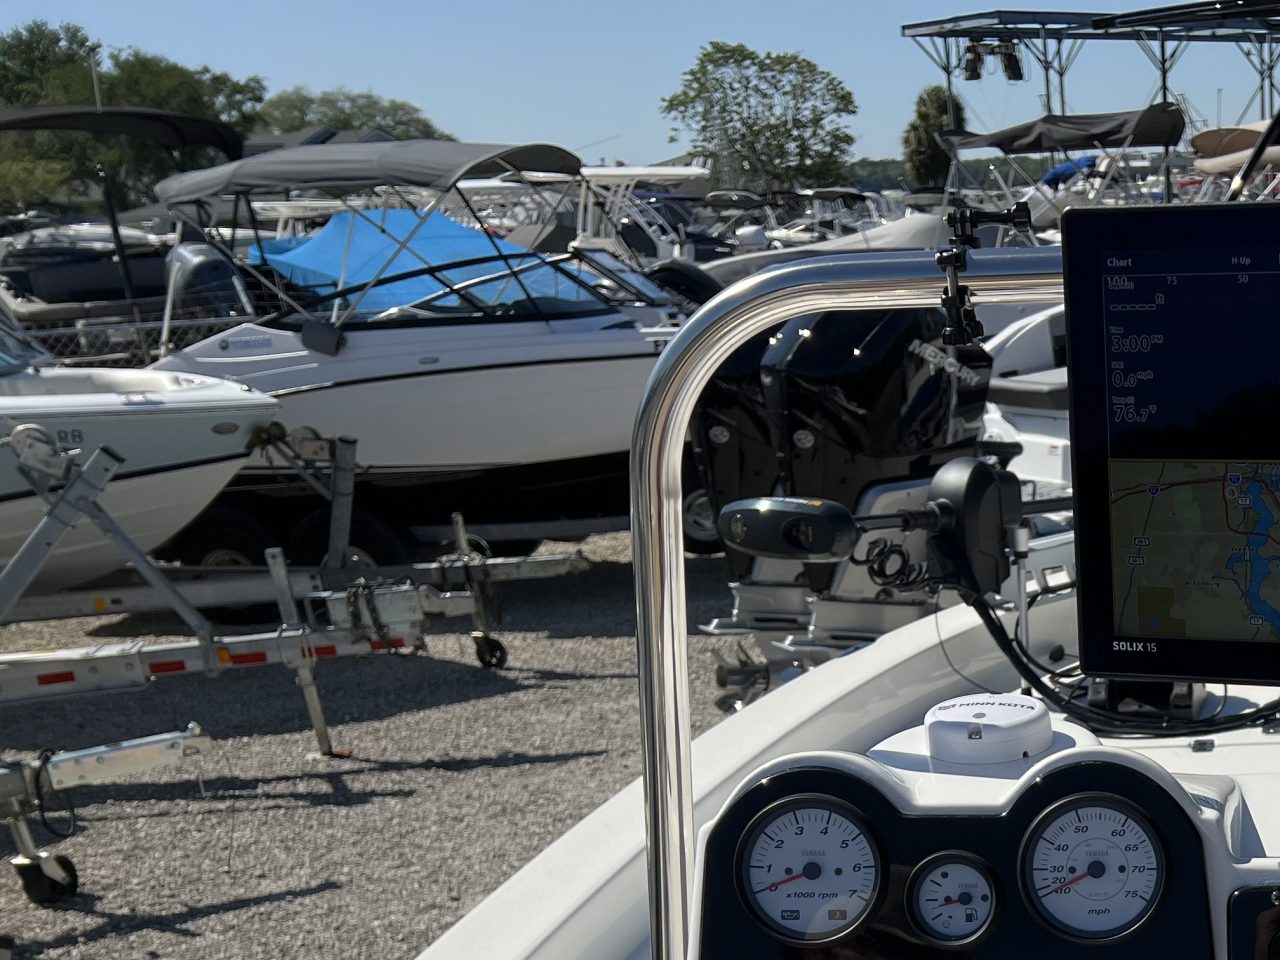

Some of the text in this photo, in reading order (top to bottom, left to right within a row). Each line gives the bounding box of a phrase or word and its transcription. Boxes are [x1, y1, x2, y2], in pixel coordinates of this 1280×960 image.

[1106, 257, 1133, 268] Chart
[1231, 256, 1251, 266] H-Up
[1167, 275, 1178, 285] 75
[1237, 274, 1249, 284] 50
[1111, 335, 1151, 353] 3:00
[1112, 370, 1154, 387] 0.0 mph
[1113, 405, 1149, 422] 76.7
[1112, 641, 1157, 653] SOLIX 15
[998, 702, 1036, 711] KOTA
[794, 826, 804, 836] 3
[819, 826, 829, 836] 4
[1073, 825, 1089, 834] 50
[1111, 829, 1126, 837] 60
[774, 839, 784, 849] 2
[840, 839, 850, 849] 5
[1054, 843, 1069, 852] 40
[1124, 843, 1139, 852] 65
[766, 863, 773, 873] 1
[852, 863, 862, 873] 6
[1049, 865, 1064, 873] 30
[1131, 865, 1146, 873] 70
[1051, 876, 1066, 885] 20
[786, 891, 838, 900] x1000 rpm
[847, 889, 858, 899] 7
[1124, 890, 1138, 898] 75
[1088, 908, 1110, 916] mph
